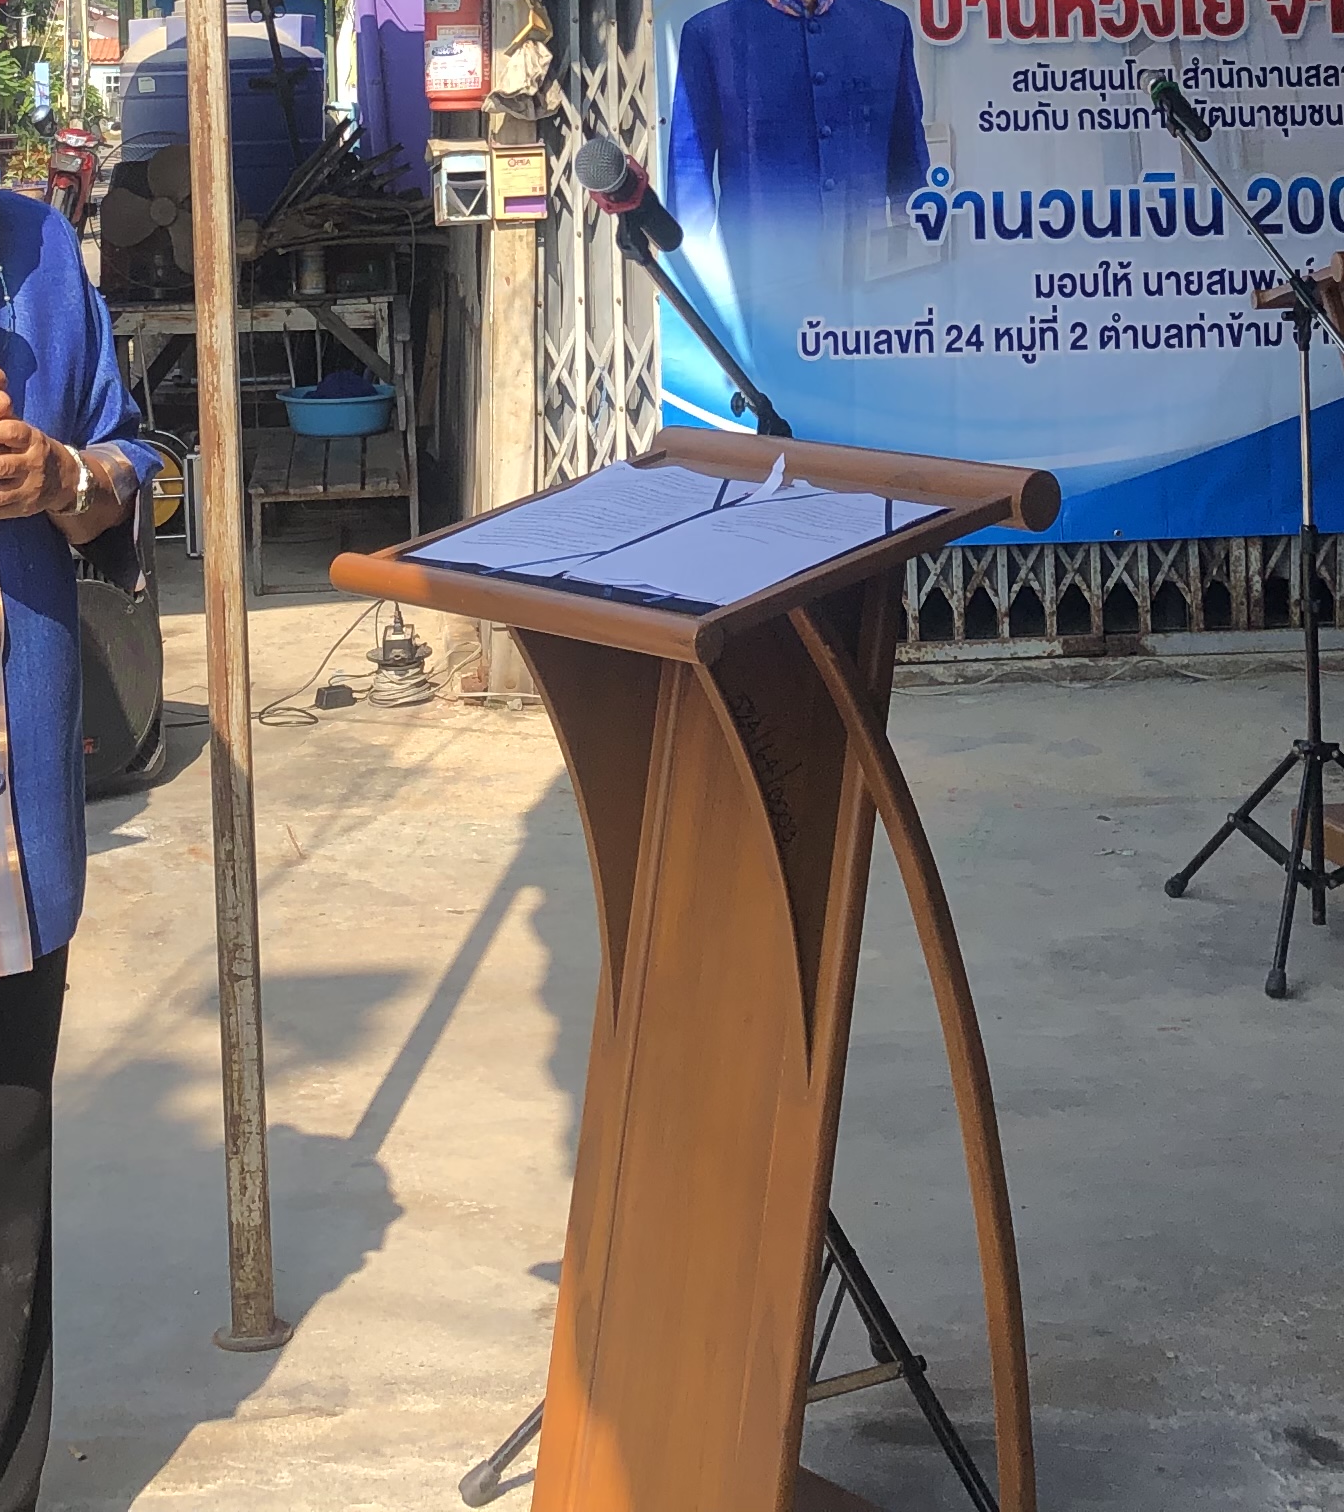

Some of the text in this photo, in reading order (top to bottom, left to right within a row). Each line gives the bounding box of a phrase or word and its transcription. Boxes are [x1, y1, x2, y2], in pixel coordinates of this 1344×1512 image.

[978, 100, 1069, 133] ร่วมกับ
[910, 166, 1225, 242] จำนวนเงิน
[1035, 260, 1133, 299] มอบให้
[800, 306, 935, 357] บ้านเลขที่
[945, 323, 985, 354] 24
[993, 304, 1060, 365] หมู่ที่
[1069, 321, 1089, 351] 2
[1098, 312, 1283, 351] ตำบลท่าข้าม
